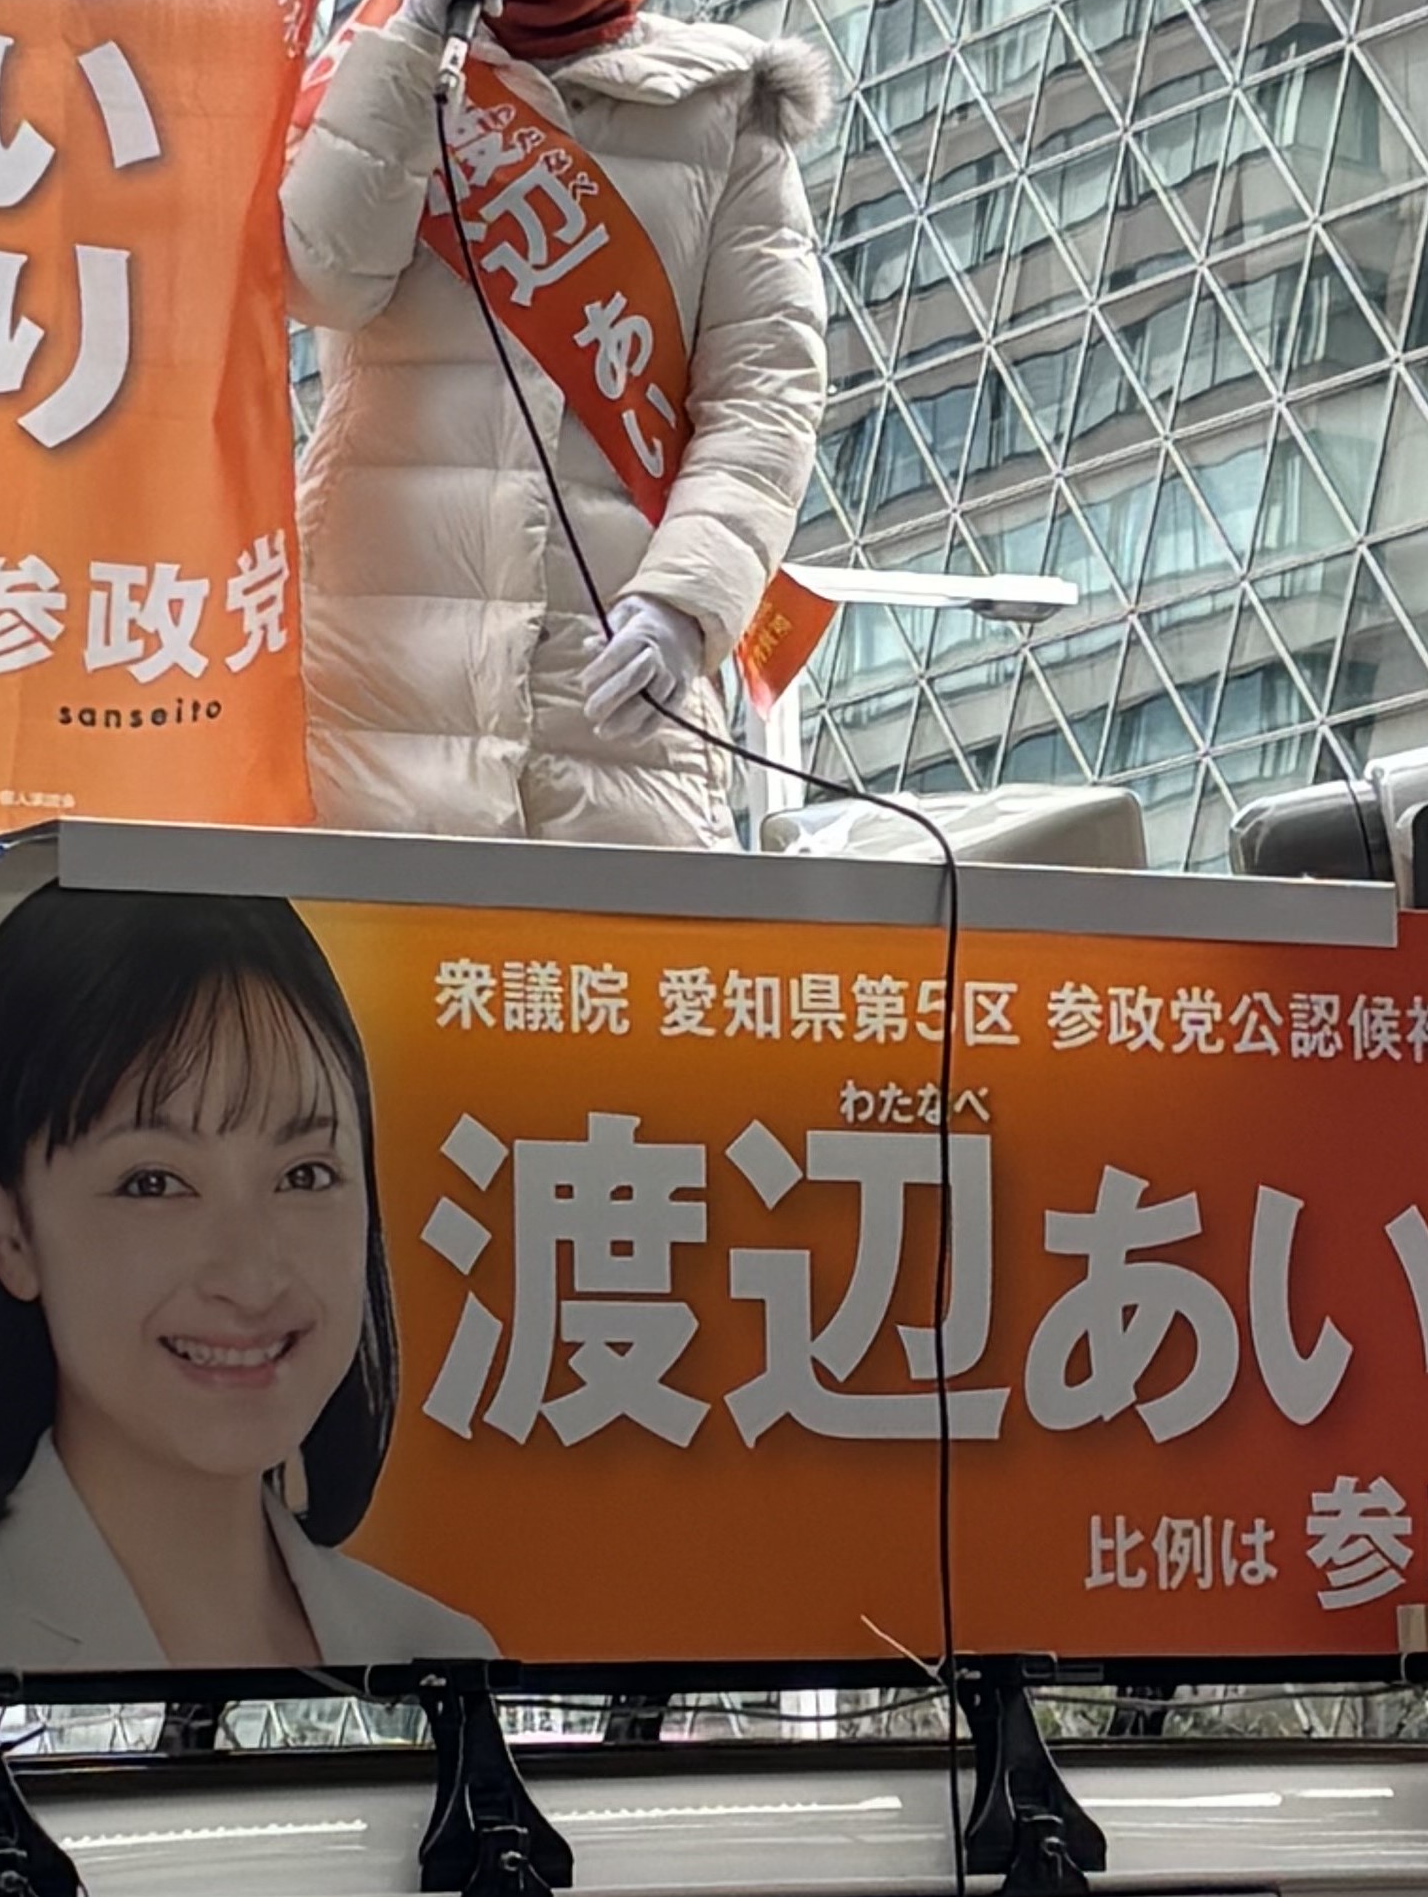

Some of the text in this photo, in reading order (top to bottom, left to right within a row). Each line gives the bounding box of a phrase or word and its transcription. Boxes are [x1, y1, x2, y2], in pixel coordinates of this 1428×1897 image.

[58, 697, 223, 730] sanseito
[434, 958, 631, 1034] 衆議院
[657, 964, 1021, 1048] 愛知県第5区
[839, 1079, 991, 1126] わたなべ
[1085, 1514, 1278, 1592] 比例は
